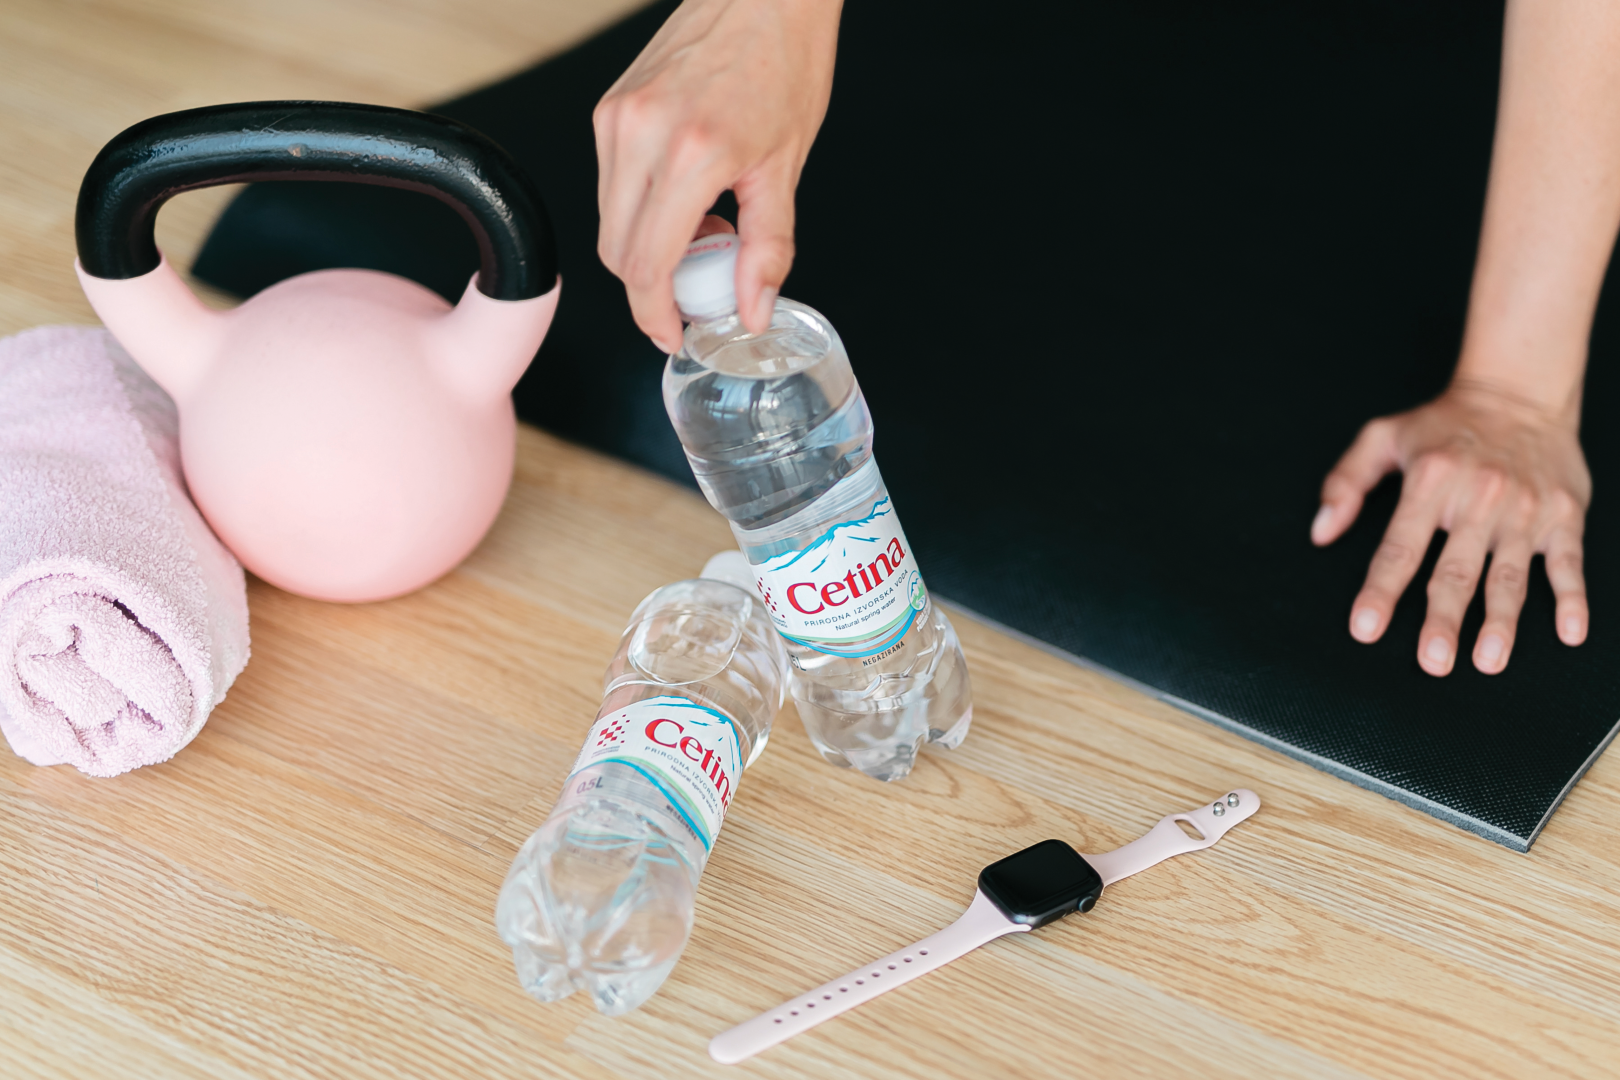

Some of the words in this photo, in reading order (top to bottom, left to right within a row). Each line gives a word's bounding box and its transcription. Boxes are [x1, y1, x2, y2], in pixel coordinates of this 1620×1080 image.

[787, 536, 906, 615] Cetina
[804, 612, 851, 627] PRIRODNA
[854, 587, 895, 615] IZVORSKA
[894, 569, 909, 588] VODA
[835, 620, 860, 632] Natural
[861, 608, 881, 622] spring
[881, 596, 897, 611] water
[862, 641, 906, 667] NEGAZIRANA
[644, 745, 691, 772] PRIRODNA
[691, 771, 719, 808] IZVORSKA
[670, 764, 691, 783] Natural
